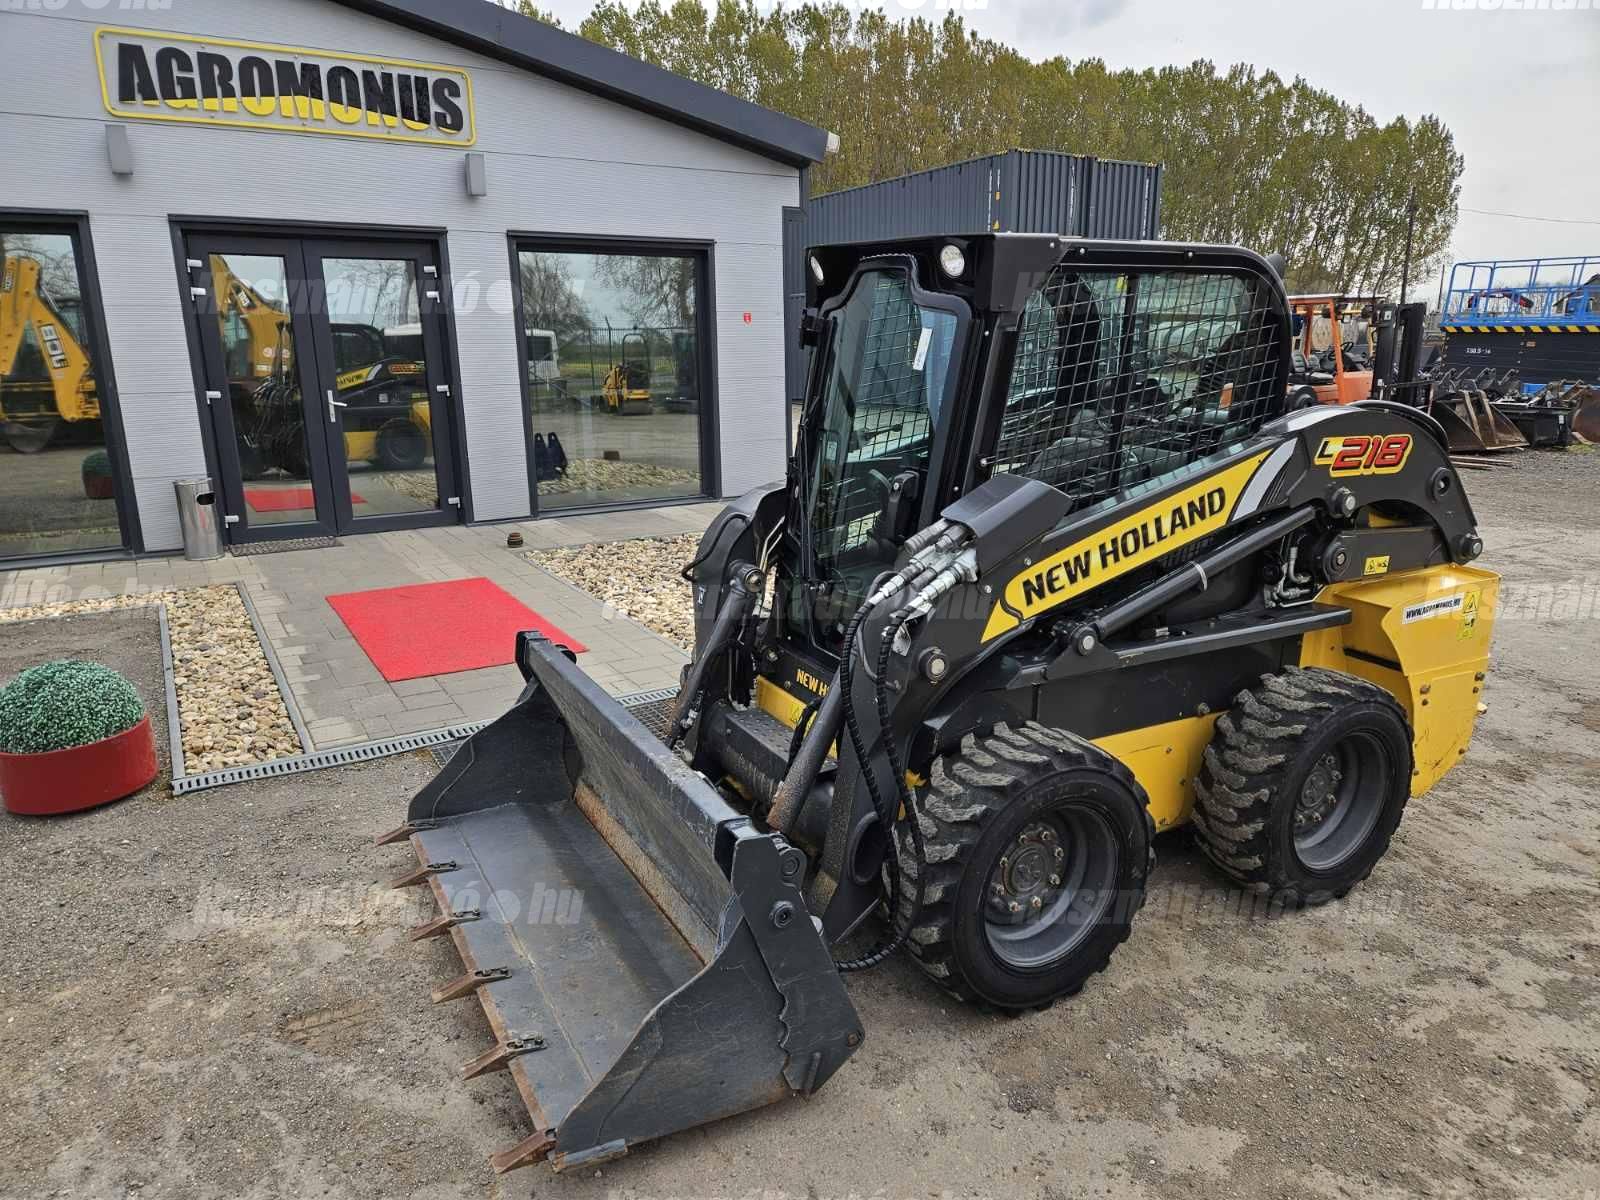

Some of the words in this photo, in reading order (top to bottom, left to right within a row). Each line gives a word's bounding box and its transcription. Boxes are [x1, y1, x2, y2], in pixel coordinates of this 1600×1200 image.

[117, 42, 464, 134] AGROMONUS
[1316, 435, 1411, 473] L218
[1021, 551, 1091, 607] NEW
[1099, 486, 1227, 569] HOLLAND
[796, 669, 818, 692] NEW
